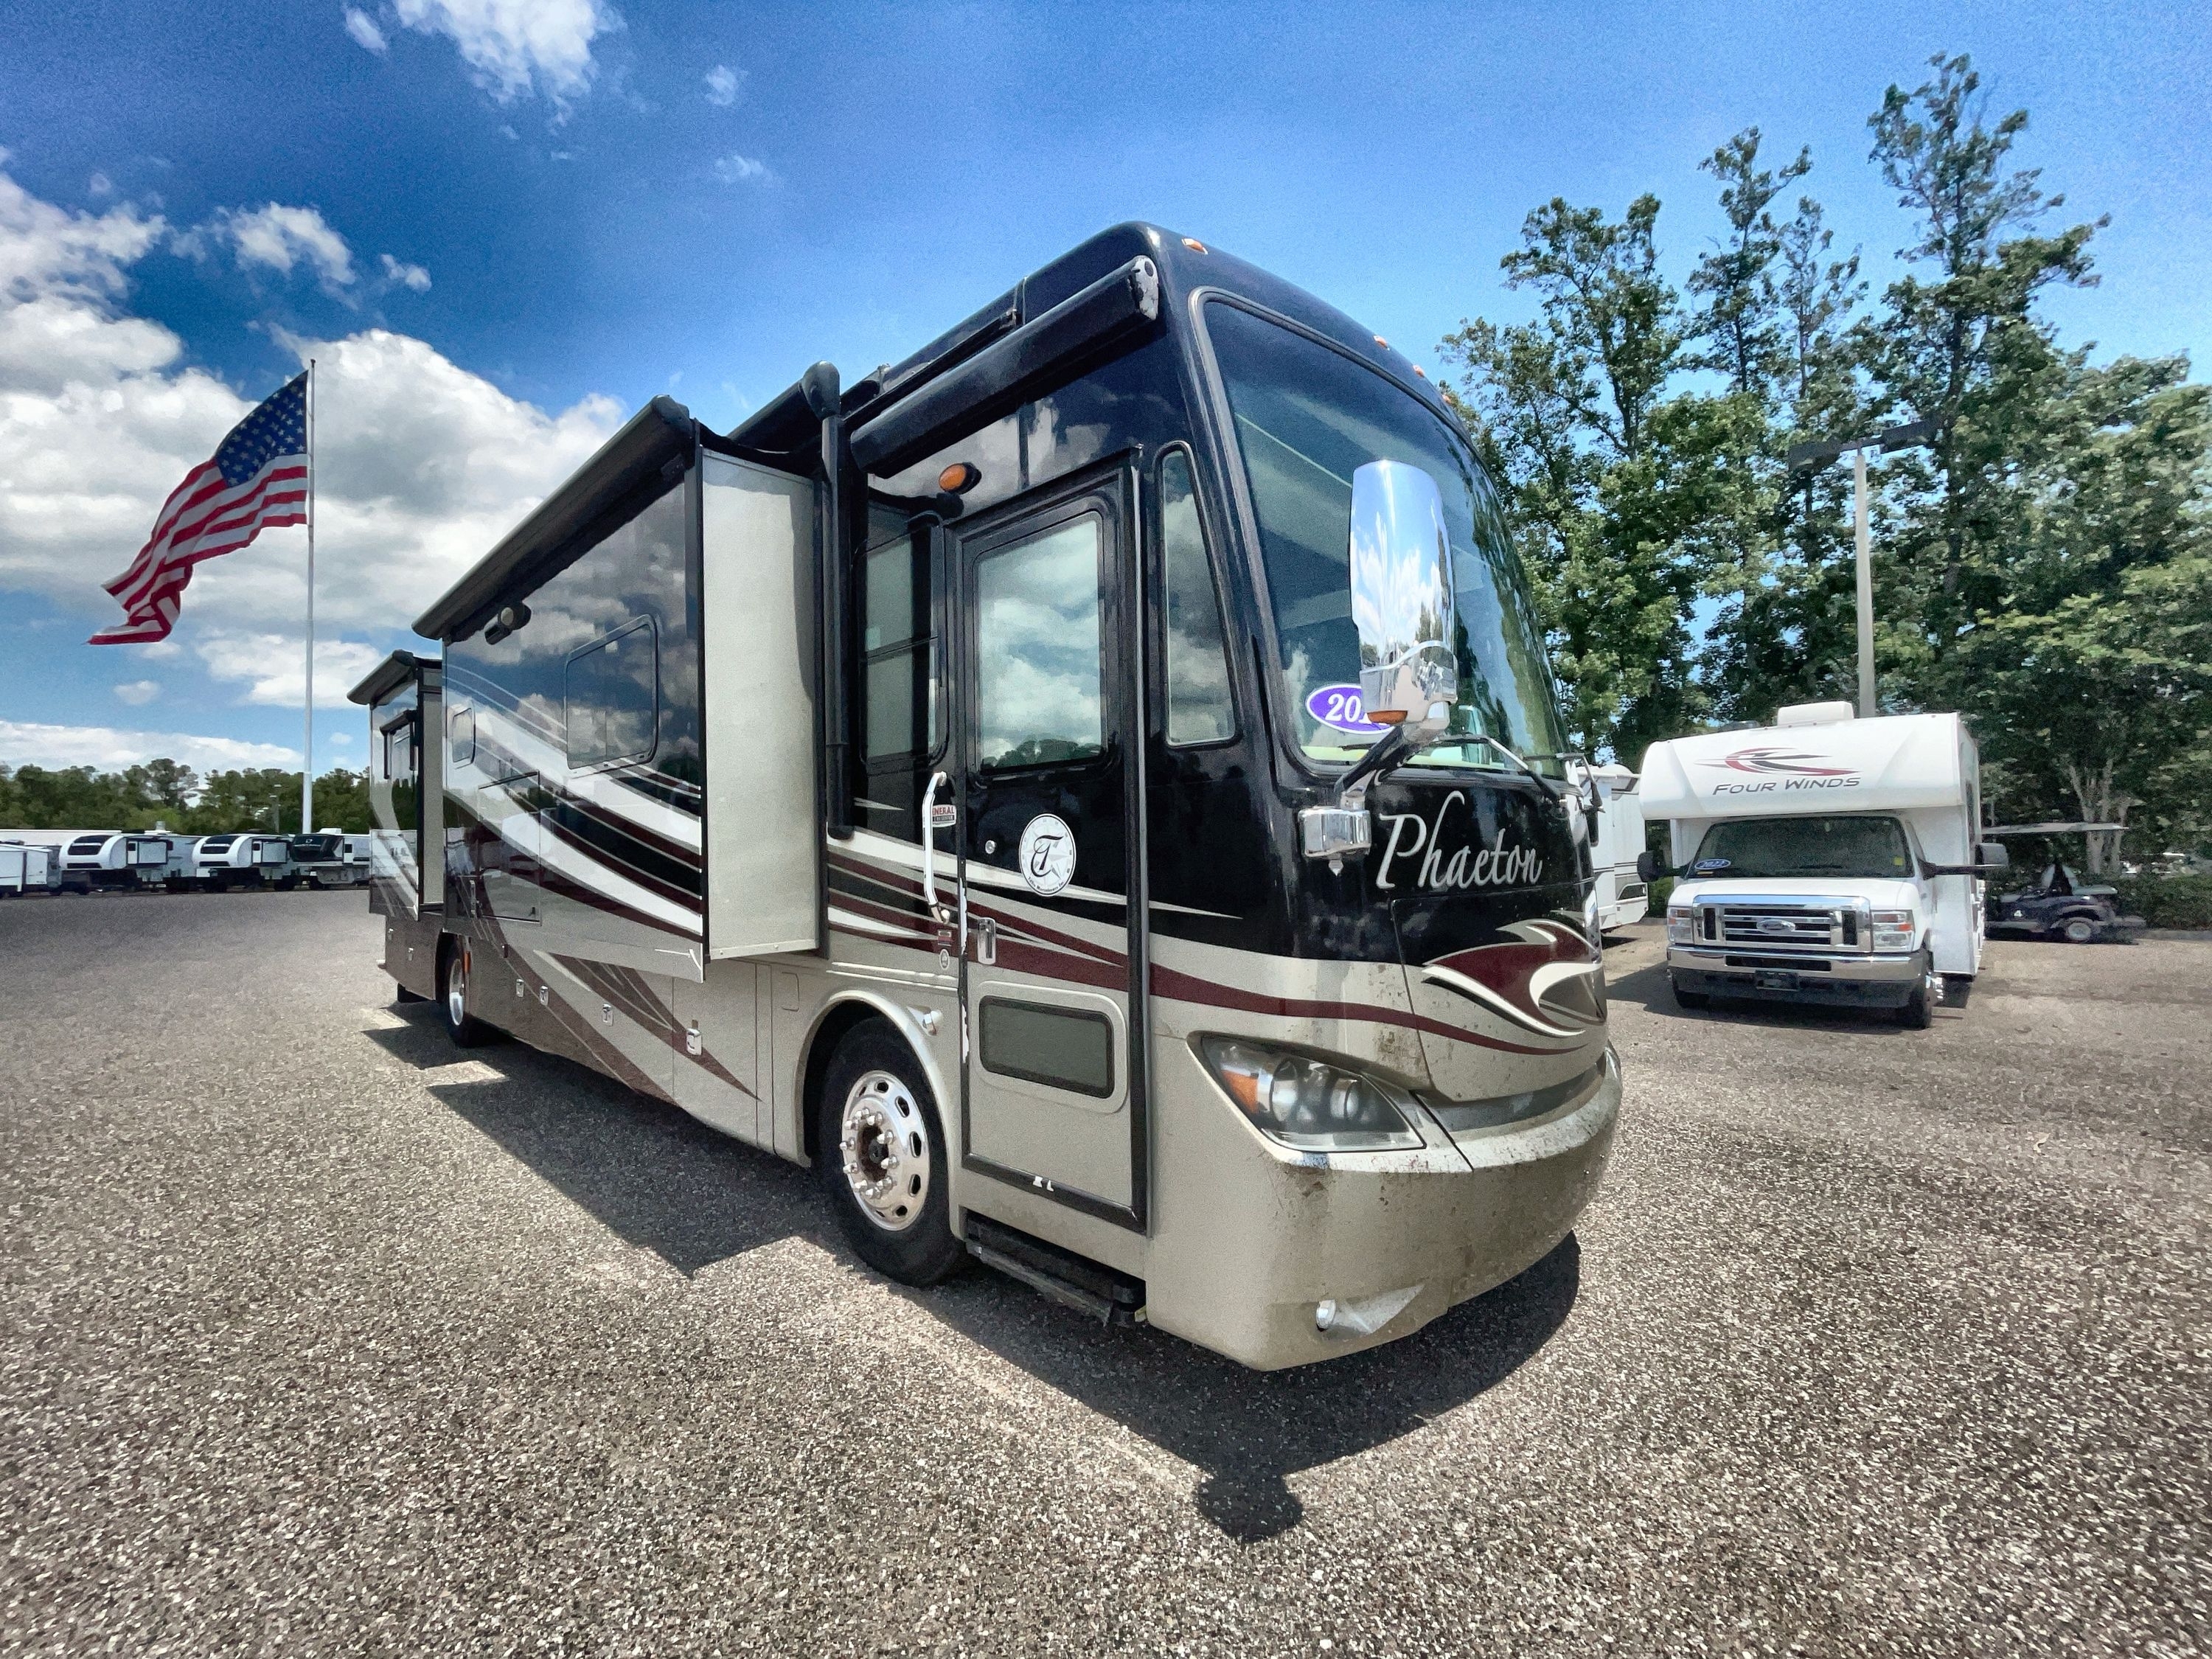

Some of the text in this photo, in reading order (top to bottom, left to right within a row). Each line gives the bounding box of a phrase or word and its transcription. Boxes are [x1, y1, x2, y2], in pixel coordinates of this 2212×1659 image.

[1712, 776, 1861, 795] FOUR WINDS
[933, 806, 955, 815] NERAL
[1376, 790, 1543, 889] Phaeton
